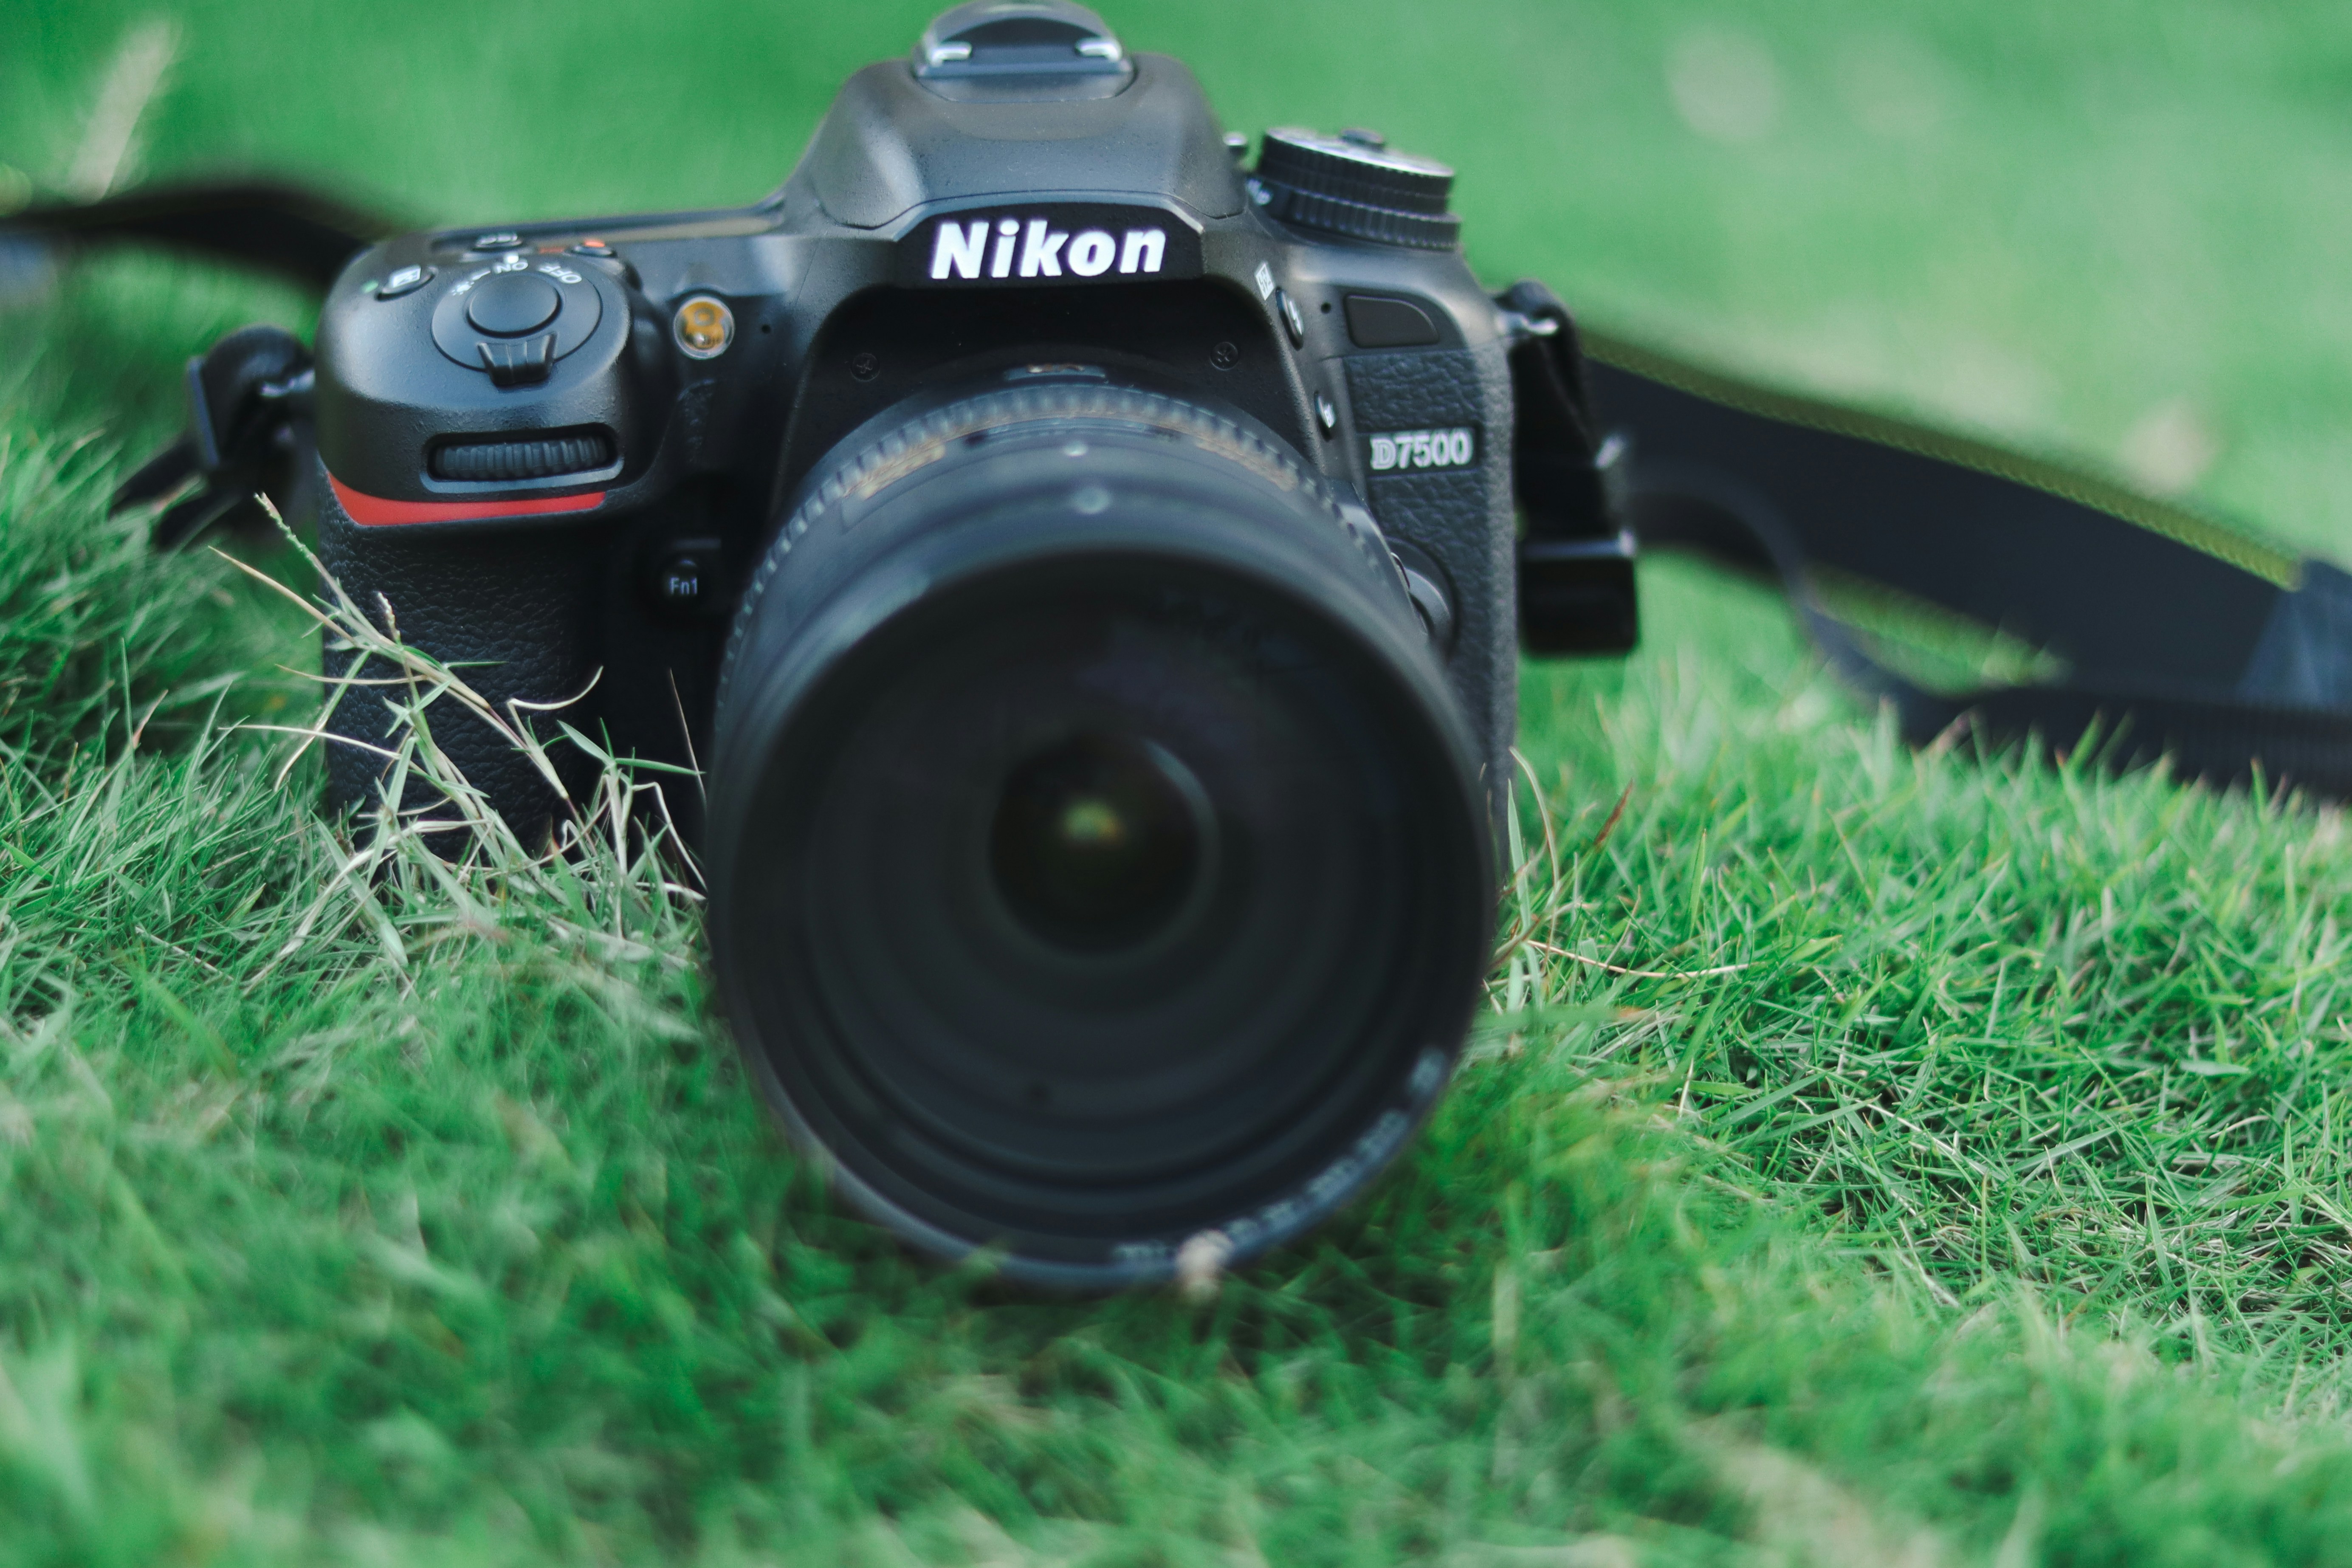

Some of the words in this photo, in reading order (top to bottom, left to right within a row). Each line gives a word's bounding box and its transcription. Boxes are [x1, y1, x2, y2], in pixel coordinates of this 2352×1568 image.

[931, 220, 1166, 279] Nikon
[538, 265, 582, 284] OFF
[1370, 430, 1473, 469] D7500
[669, 577, 697, 594] Fn1
